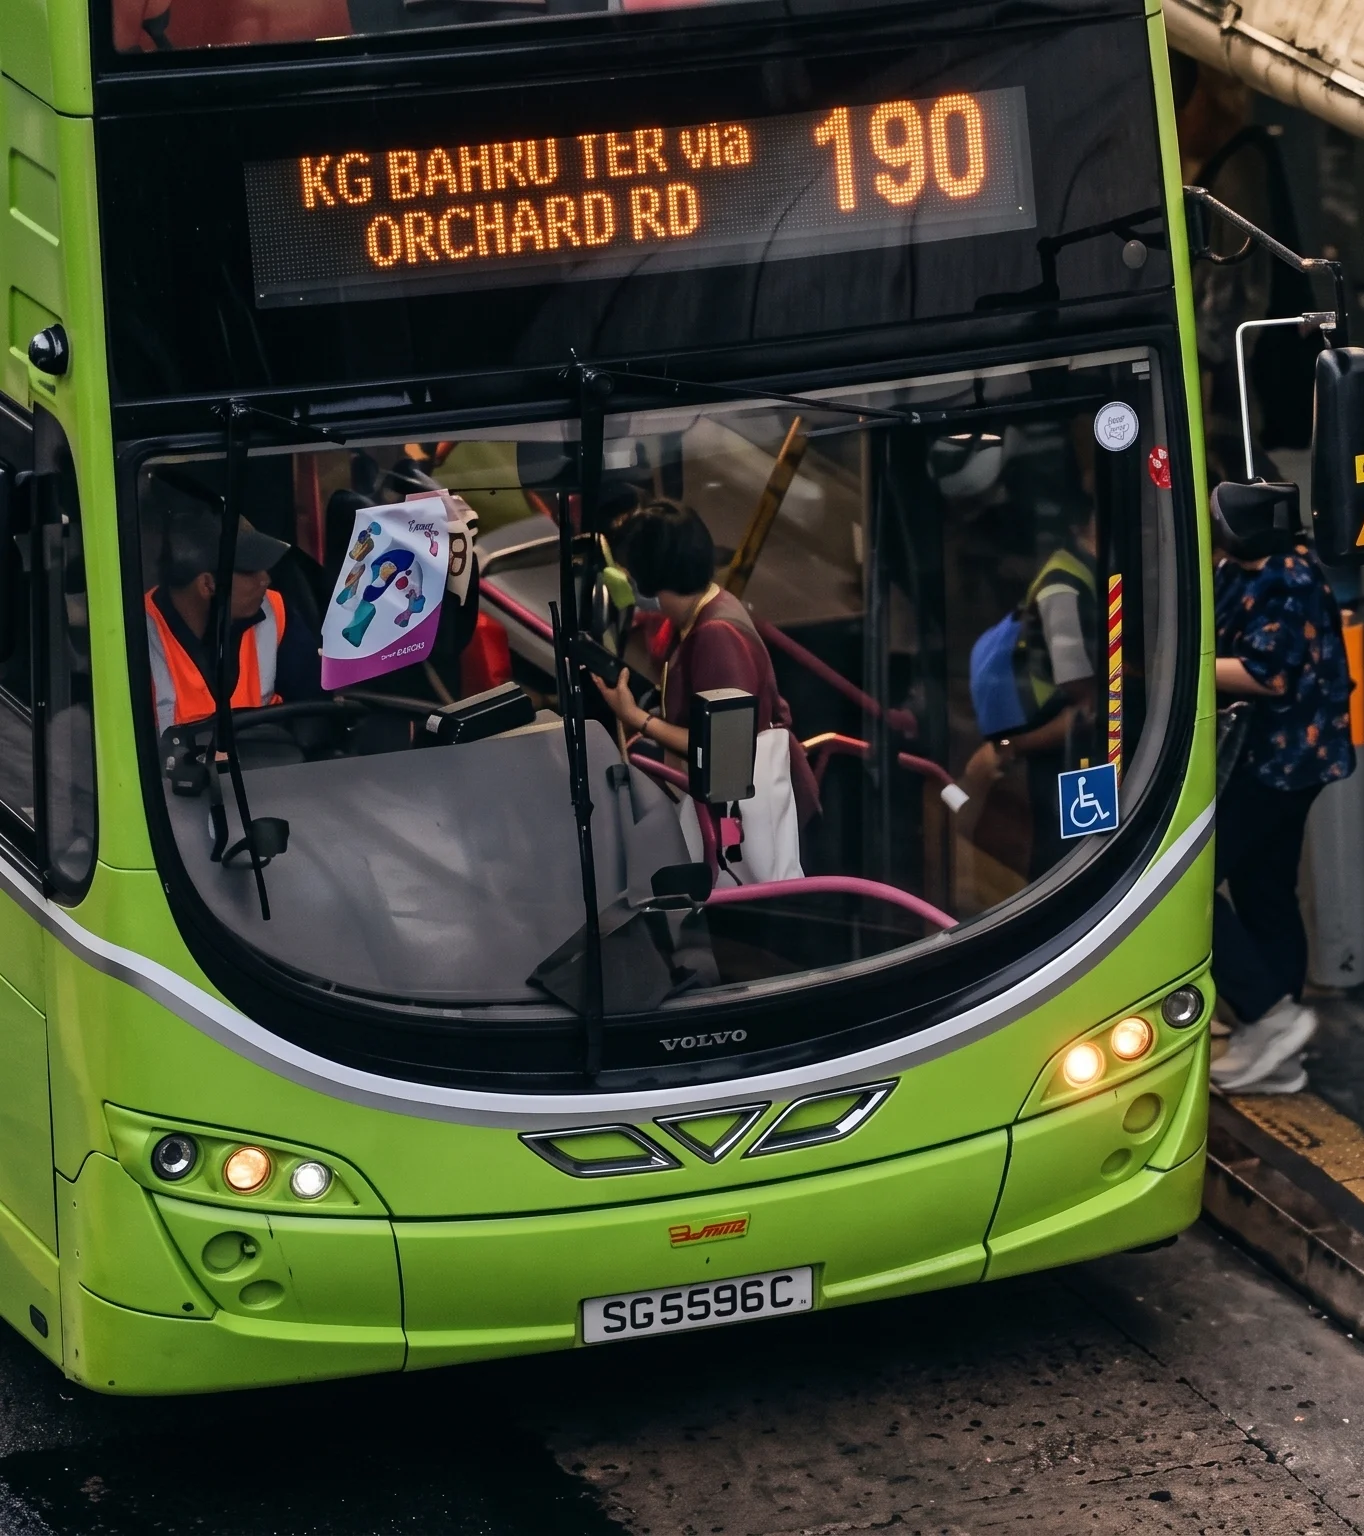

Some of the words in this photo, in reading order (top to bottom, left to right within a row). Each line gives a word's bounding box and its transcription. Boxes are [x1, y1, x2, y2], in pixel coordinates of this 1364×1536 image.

[301, 152, 373, 208] KG
[387, 138, 559, 200] BAHRU
[576, 127, 669, 180] TER
[680, 121, 751, 169] via
[813, 92, 986, 212] 190
[366, 191, 617, 268] ORCHARD
[630, 181, 702, 241] RD
[659, 1028, 748, 1051] VOLVO
[602, 1274, 795, 1334] SG5596C
